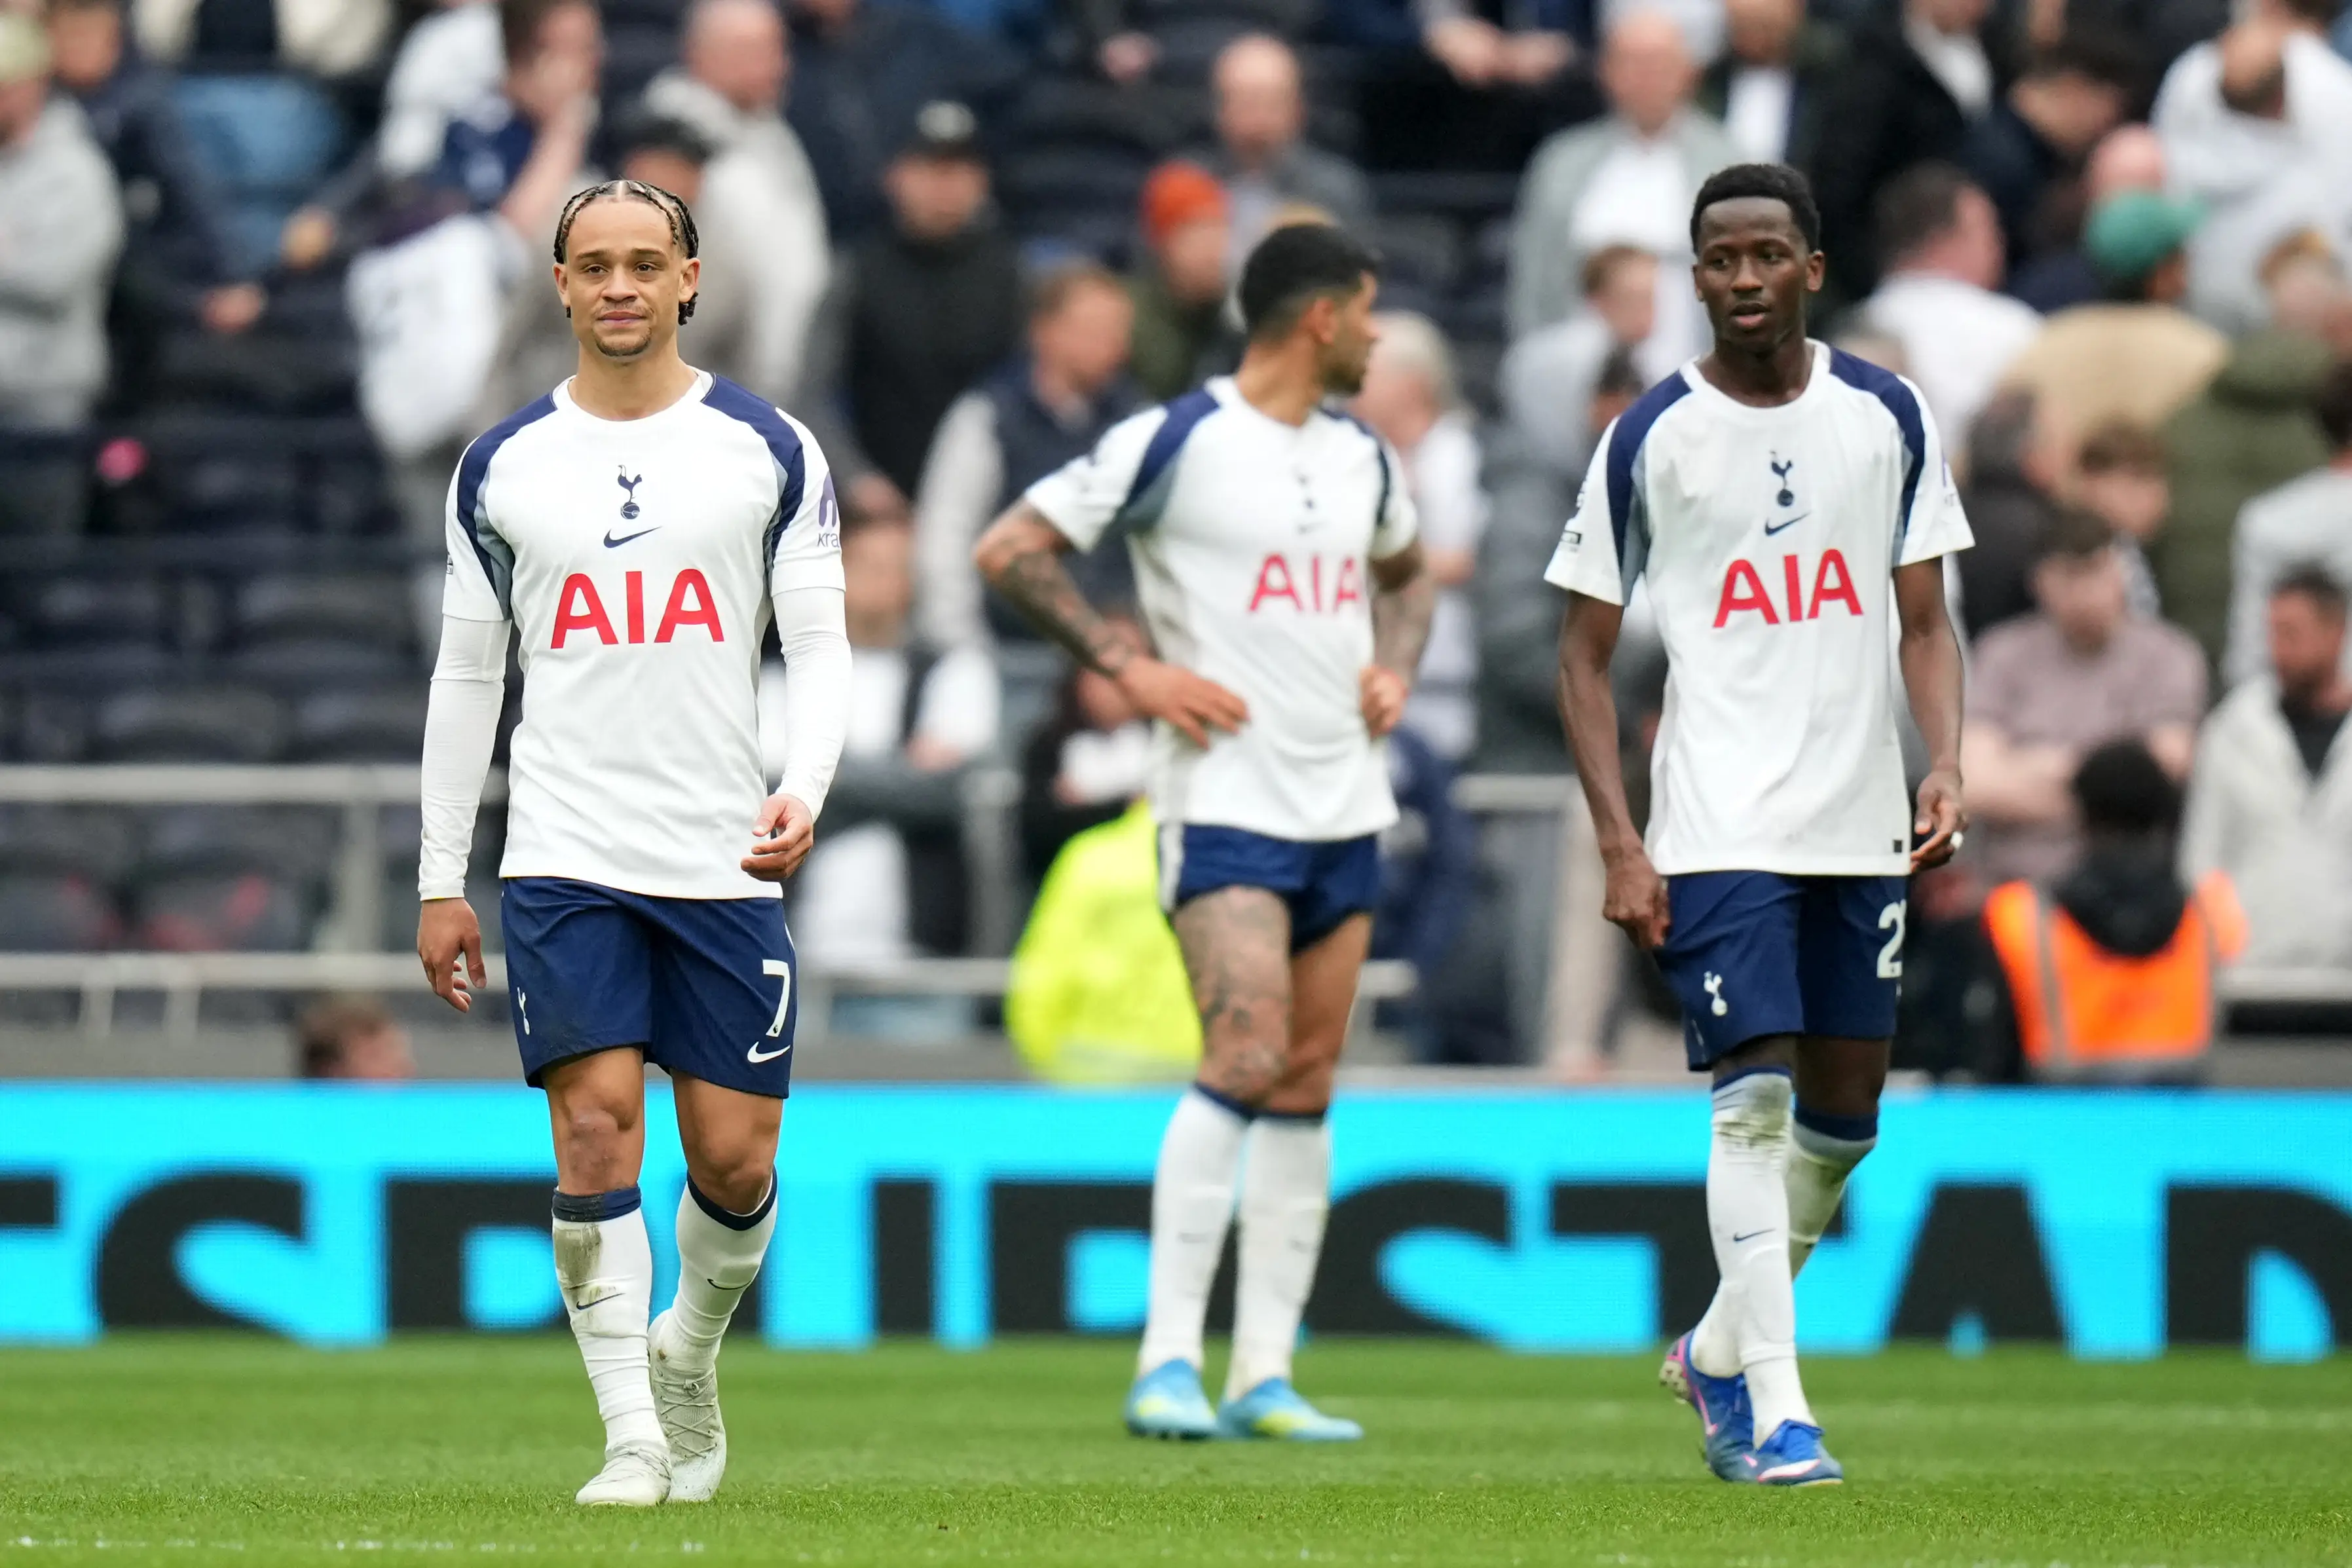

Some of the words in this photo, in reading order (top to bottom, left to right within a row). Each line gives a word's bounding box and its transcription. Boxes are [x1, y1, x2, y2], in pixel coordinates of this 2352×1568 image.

[550, 568, 725, 650] AIA
[1248, 553, 1360, 612] AIA
[1711, 548, 1864, 629] AIA
[762, 959, 791, 1037] 7
